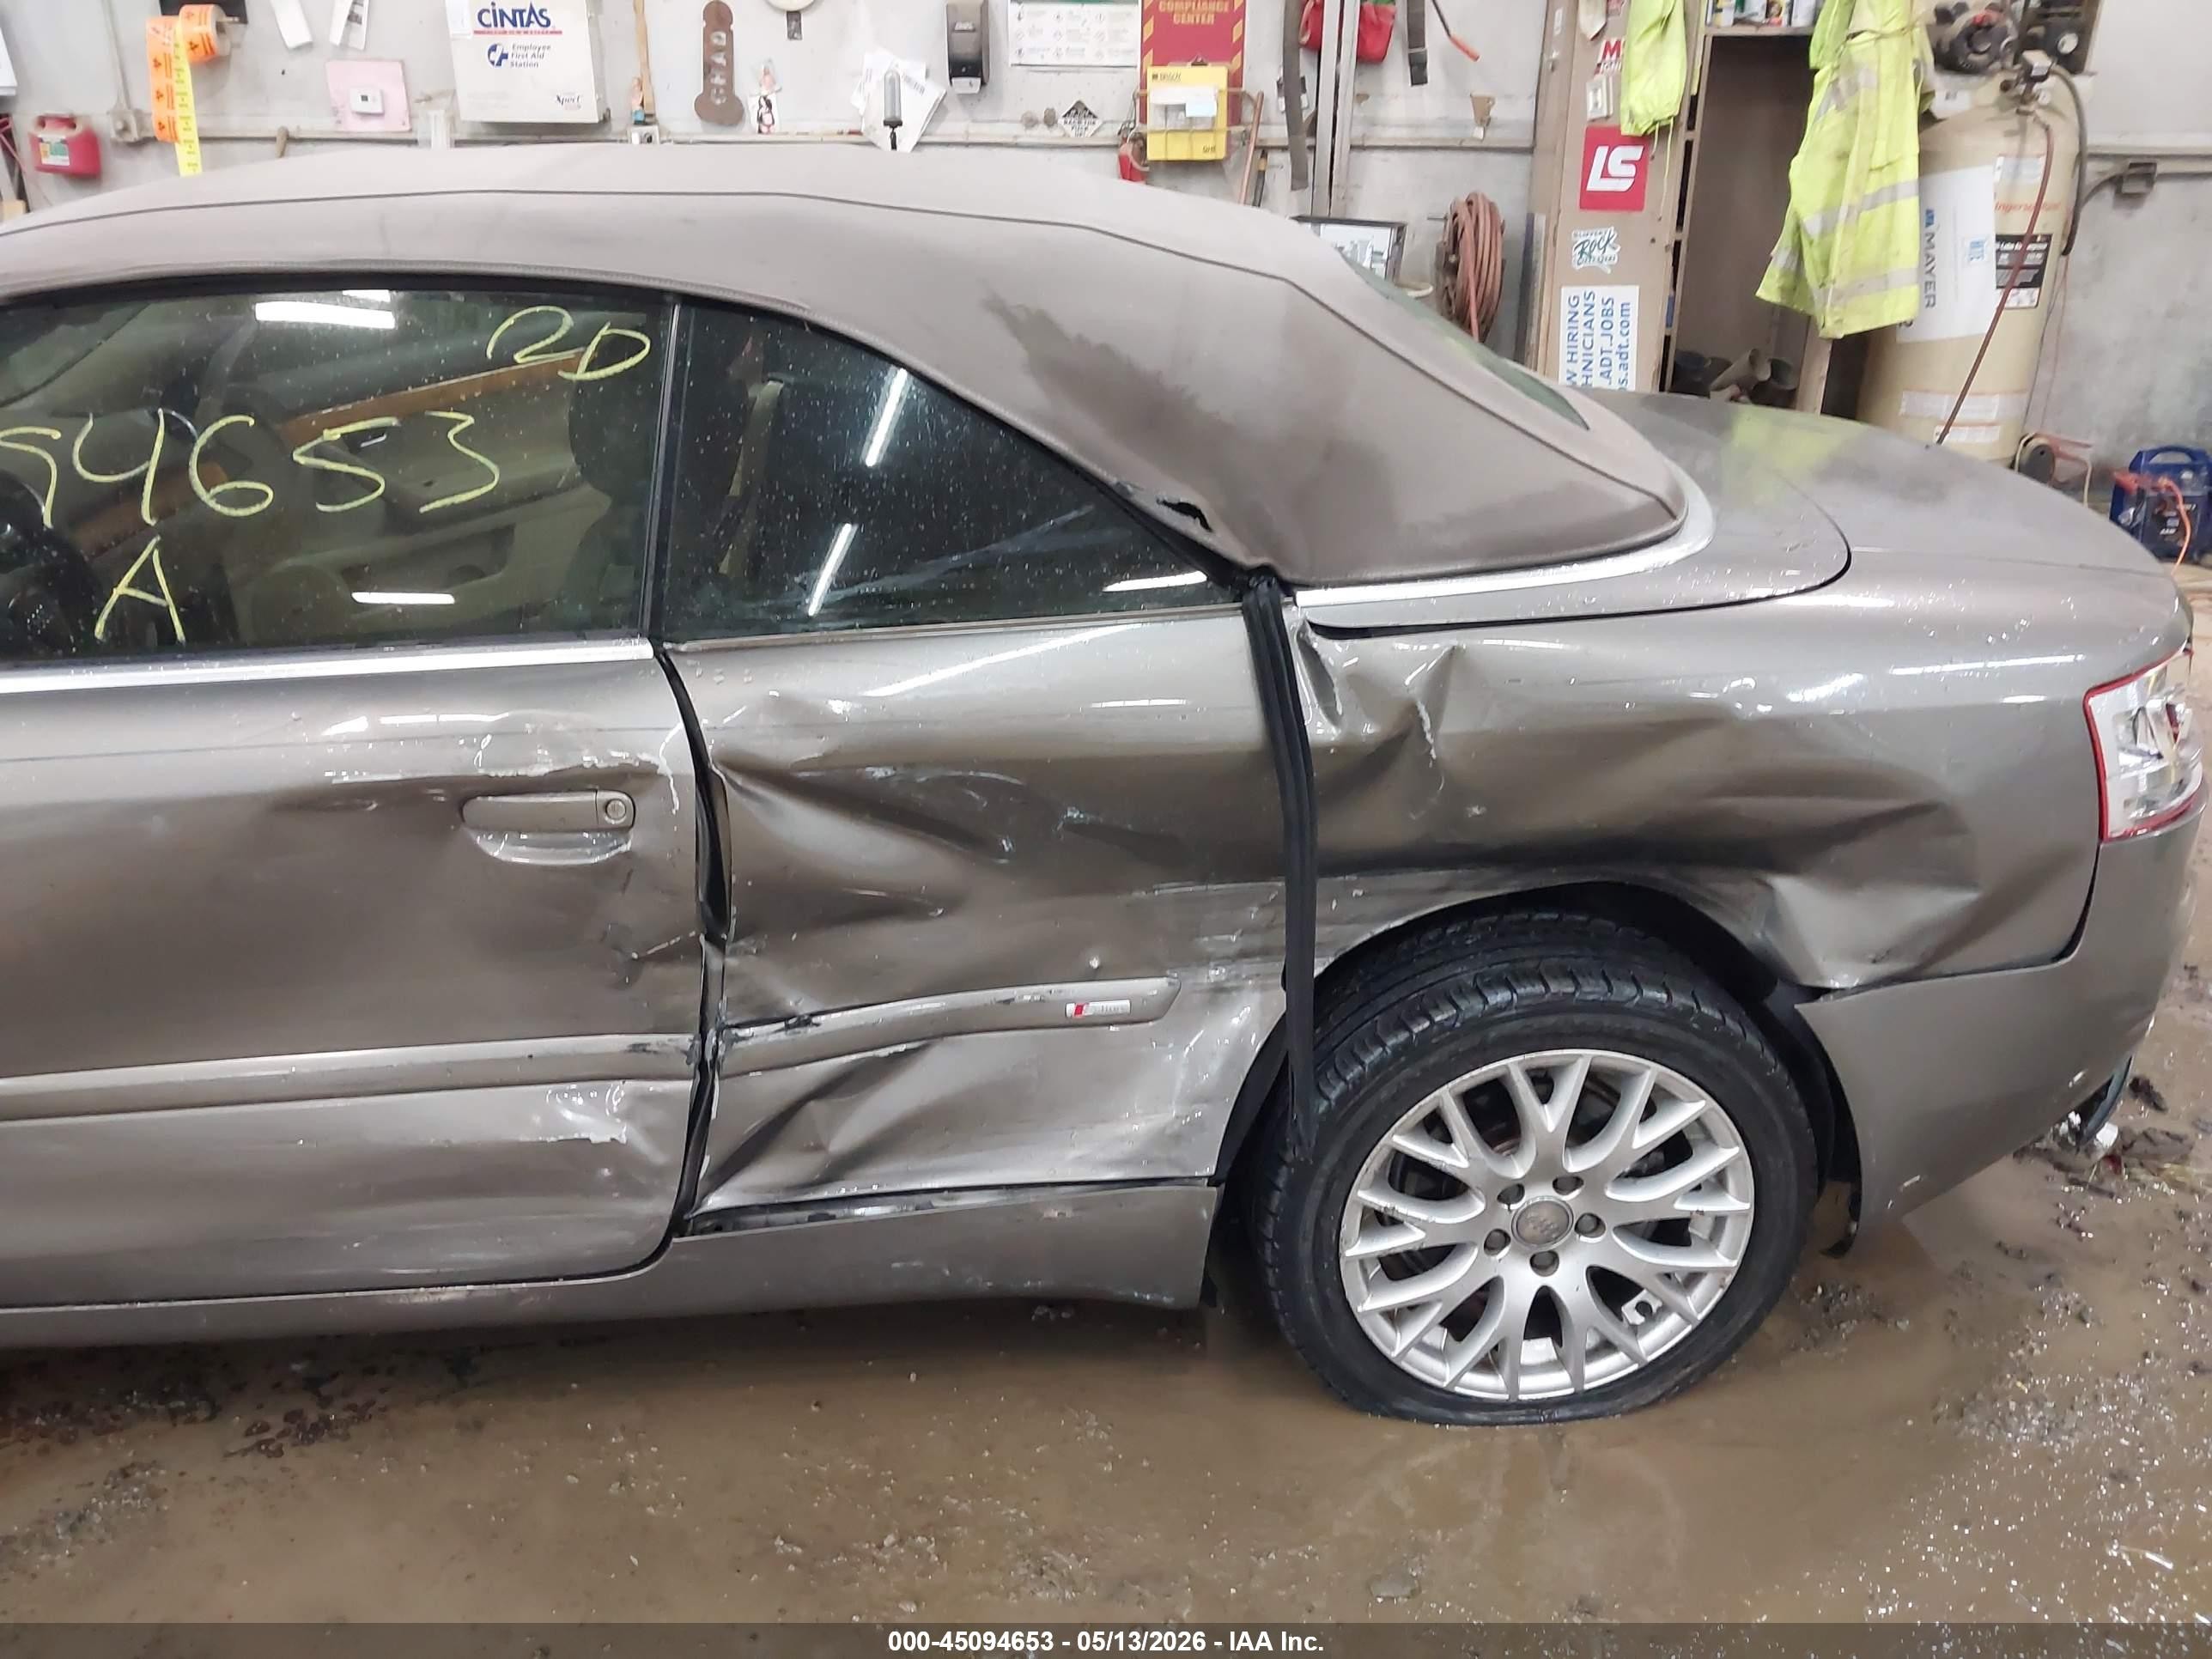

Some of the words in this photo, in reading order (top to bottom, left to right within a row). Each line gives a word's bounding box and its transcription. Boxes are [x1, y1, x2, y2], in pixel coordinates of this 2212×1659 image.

[477, 2, 551, 28] CINTAS
[1159, 0, 1230, 13] COMPLIANCE
[1174, 13, 1214, 24] CENTER
[512, 44, 551, 54] Employee
[1586, 145, 1644, 191] LS
[1923, 232, 1936, 308] MAYER
[1566, 295, 1580, 363] HIRING
[1581, 290, 1595, 388] HNICIANS
[94, 535, 186, 645] A
